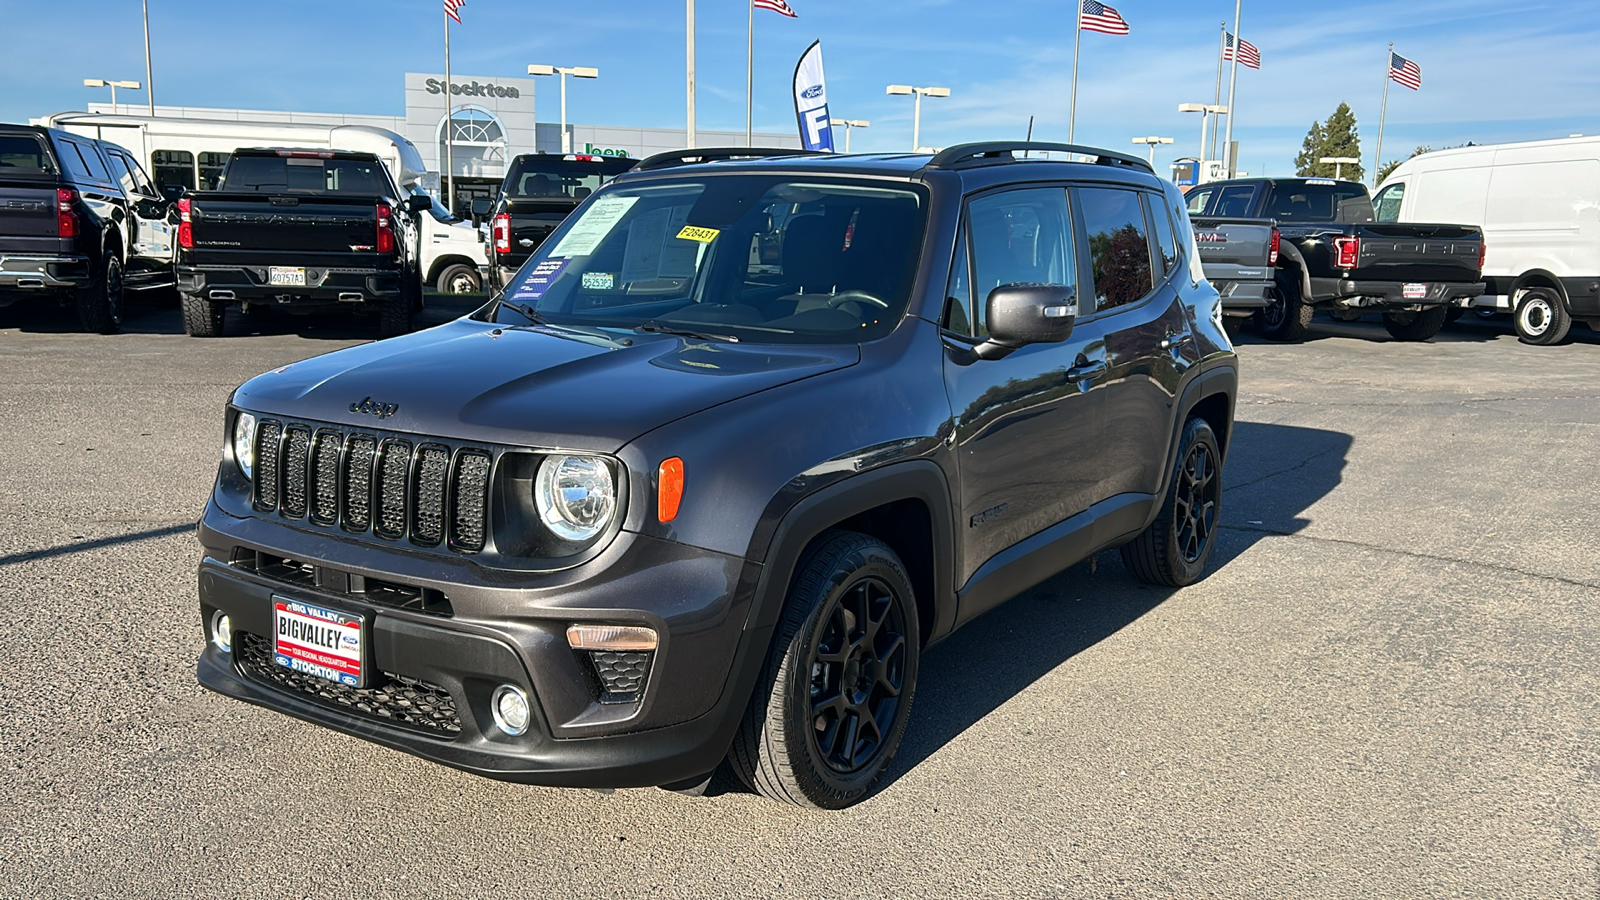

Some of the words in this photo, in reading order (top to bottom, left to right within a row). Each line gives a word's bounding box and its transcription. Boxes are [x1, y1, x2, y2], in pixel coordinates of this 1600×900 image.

[425, 78, 519, 98] Stockton
[804, 86, 823, 98] Ford
[680, 227, 716, 240] F28431
[1361, 241, 1477, 255] FORD
[272, 273, 304, 283] 60757A3
[349, 396, 399, 419] Jeep
[292, 602, 307, 614] BIG
[307, 606, 339, 622] VALLEY
[279, 616, 342, 650] BIGVALLEY
[291, 658, 339, 681] STOCKTON
